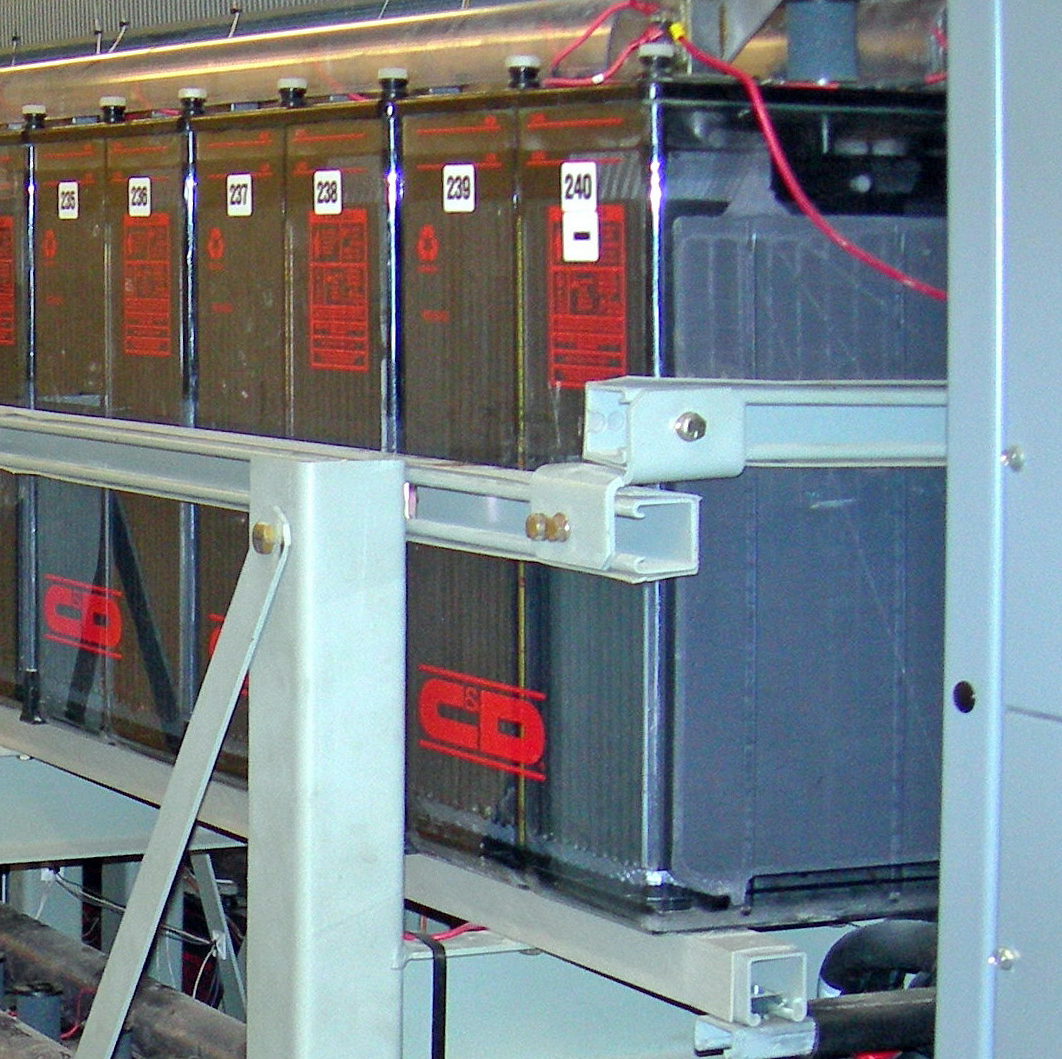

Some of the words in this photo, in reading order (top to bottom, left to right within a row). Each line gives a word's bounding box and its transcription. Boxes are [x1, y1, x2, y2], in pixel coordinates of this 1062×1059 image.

[130, 185, 148, 206] 236
[229, 182, 249, 205] 237
[316, 179, 338, 204] 238
[446, 175, 471, 200] 239
[564, 174, 593, 200] 240
